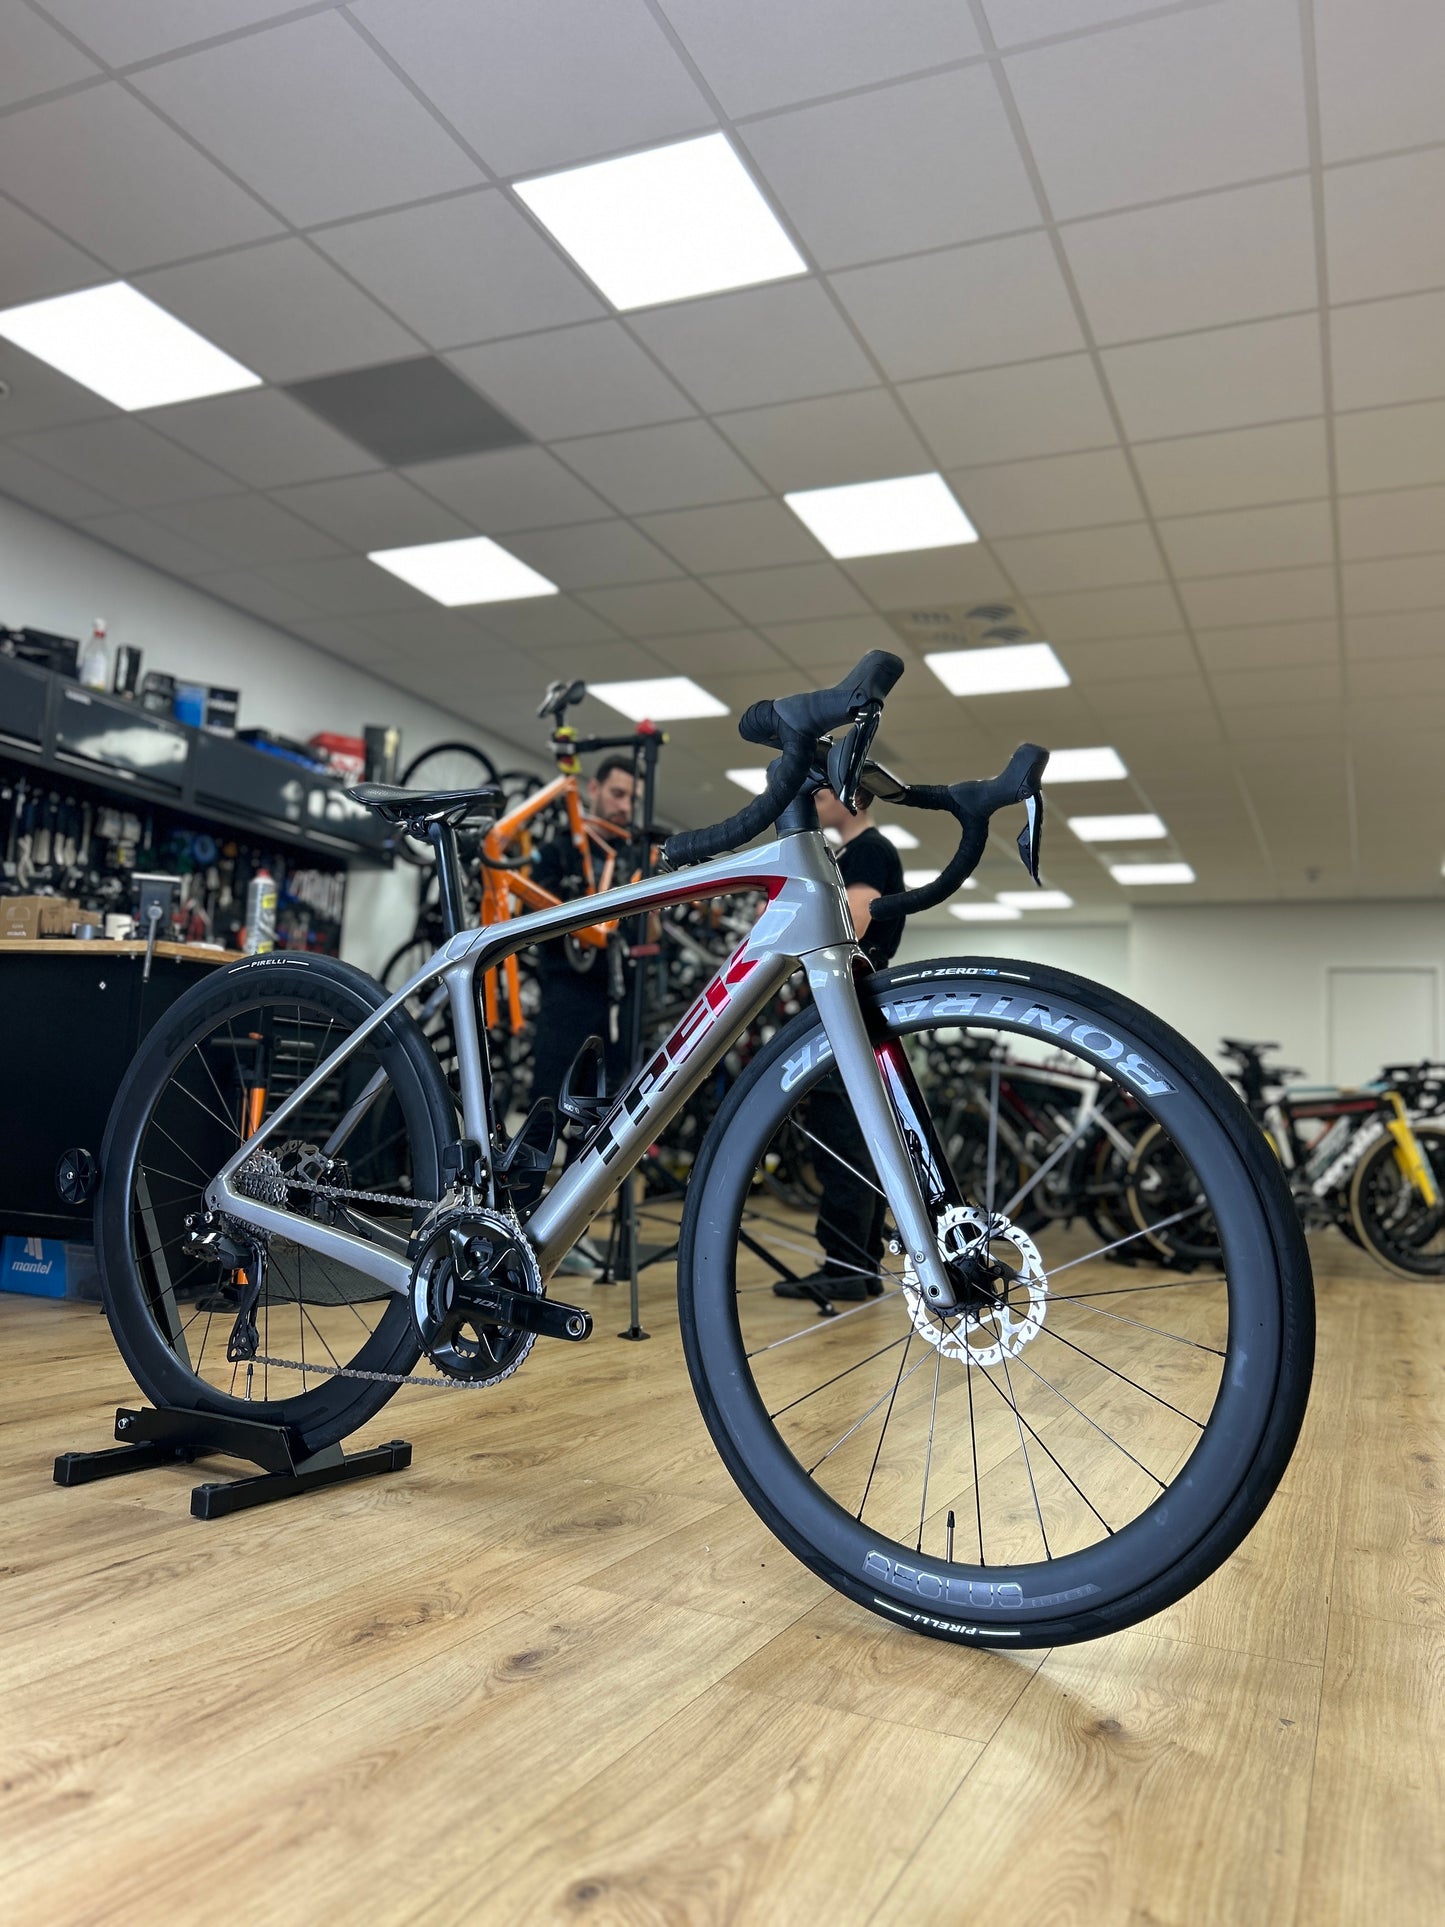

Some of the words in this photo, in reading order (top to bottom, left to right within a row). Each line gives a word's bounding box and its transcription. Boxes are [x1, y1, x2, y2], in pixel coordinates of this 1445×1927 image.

[250, 958, 287, 968] PIRELLI
[920, 969, 932, 978] P
[934, 967, 979, 976] ZERO
[579, 937, 761, 1166] TREK
[11, 1260, 53, 1275] mantel
[863, 1549, 1025, 1609] AEOLUS
[913, 1614, 977, 1635] PIRELLI
